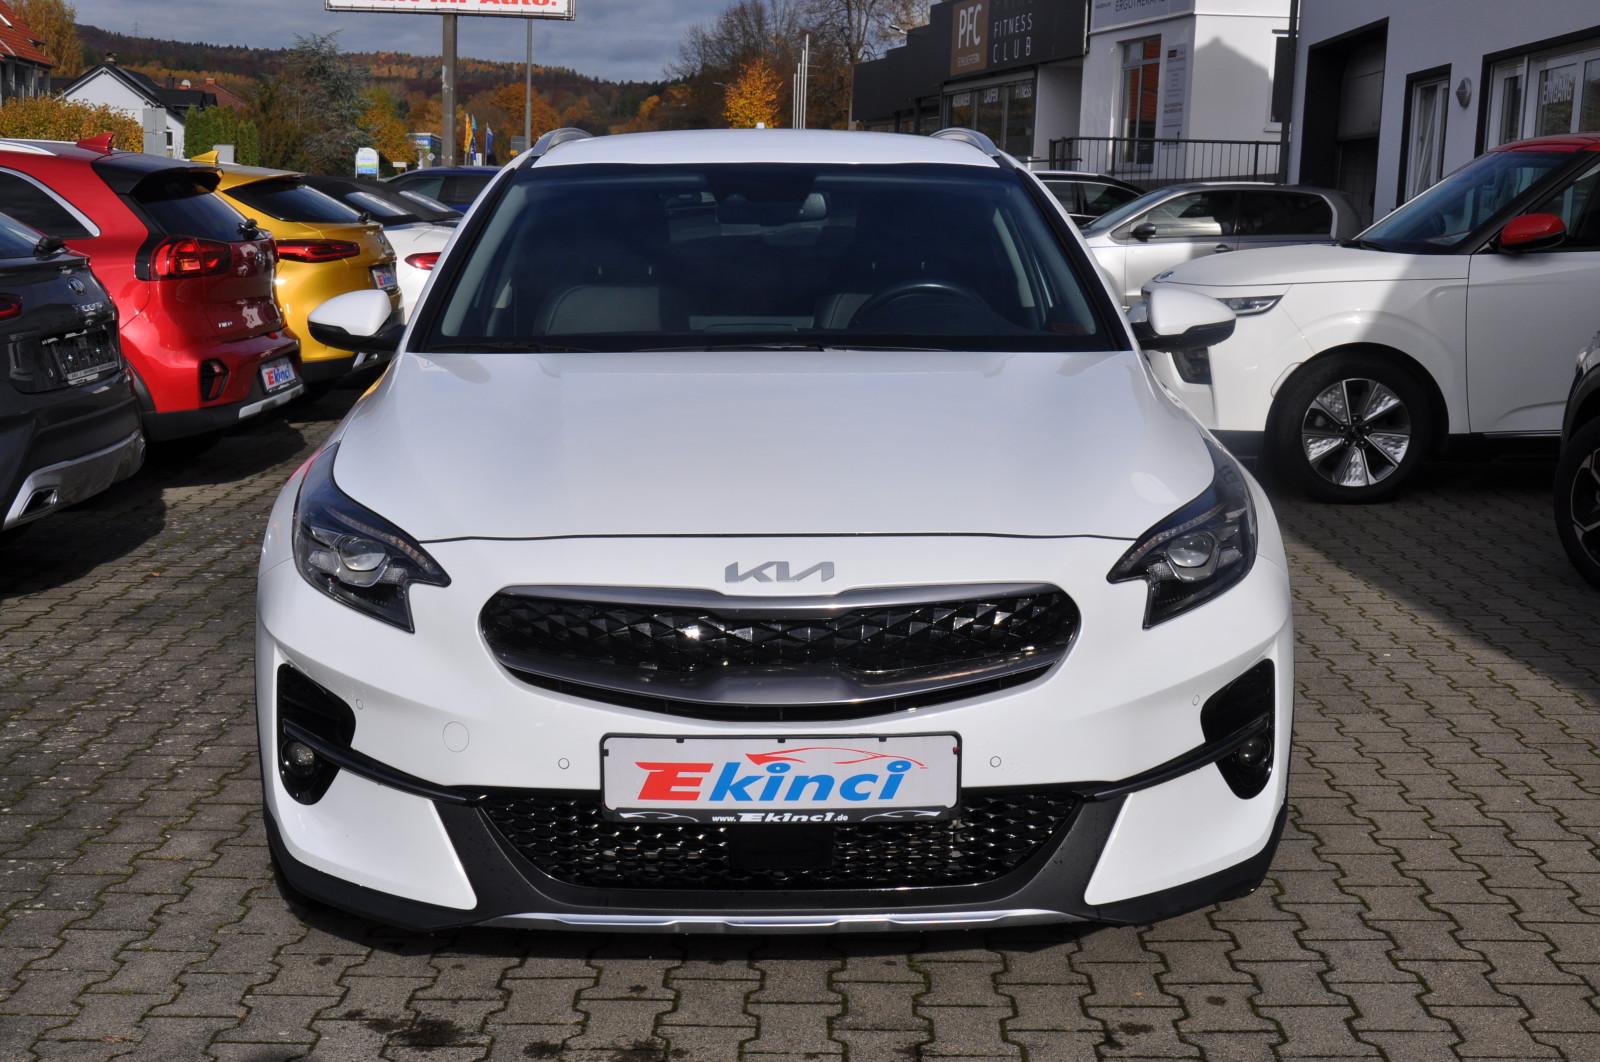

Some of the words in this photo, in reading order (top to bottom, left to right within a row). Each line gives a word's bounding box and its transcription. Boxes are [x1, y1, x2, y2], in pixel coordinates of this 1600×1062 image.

[958, 3, 983, 49] PFC
[993, 12, 1033, 39] FITNESS
[992, 36, 1032, 63] CLUB
[725, 561, 835, 583] KIA
[634, 760, 912, 802] Ekinci
[711, 812, 849, 823] www.Ekinci.de
